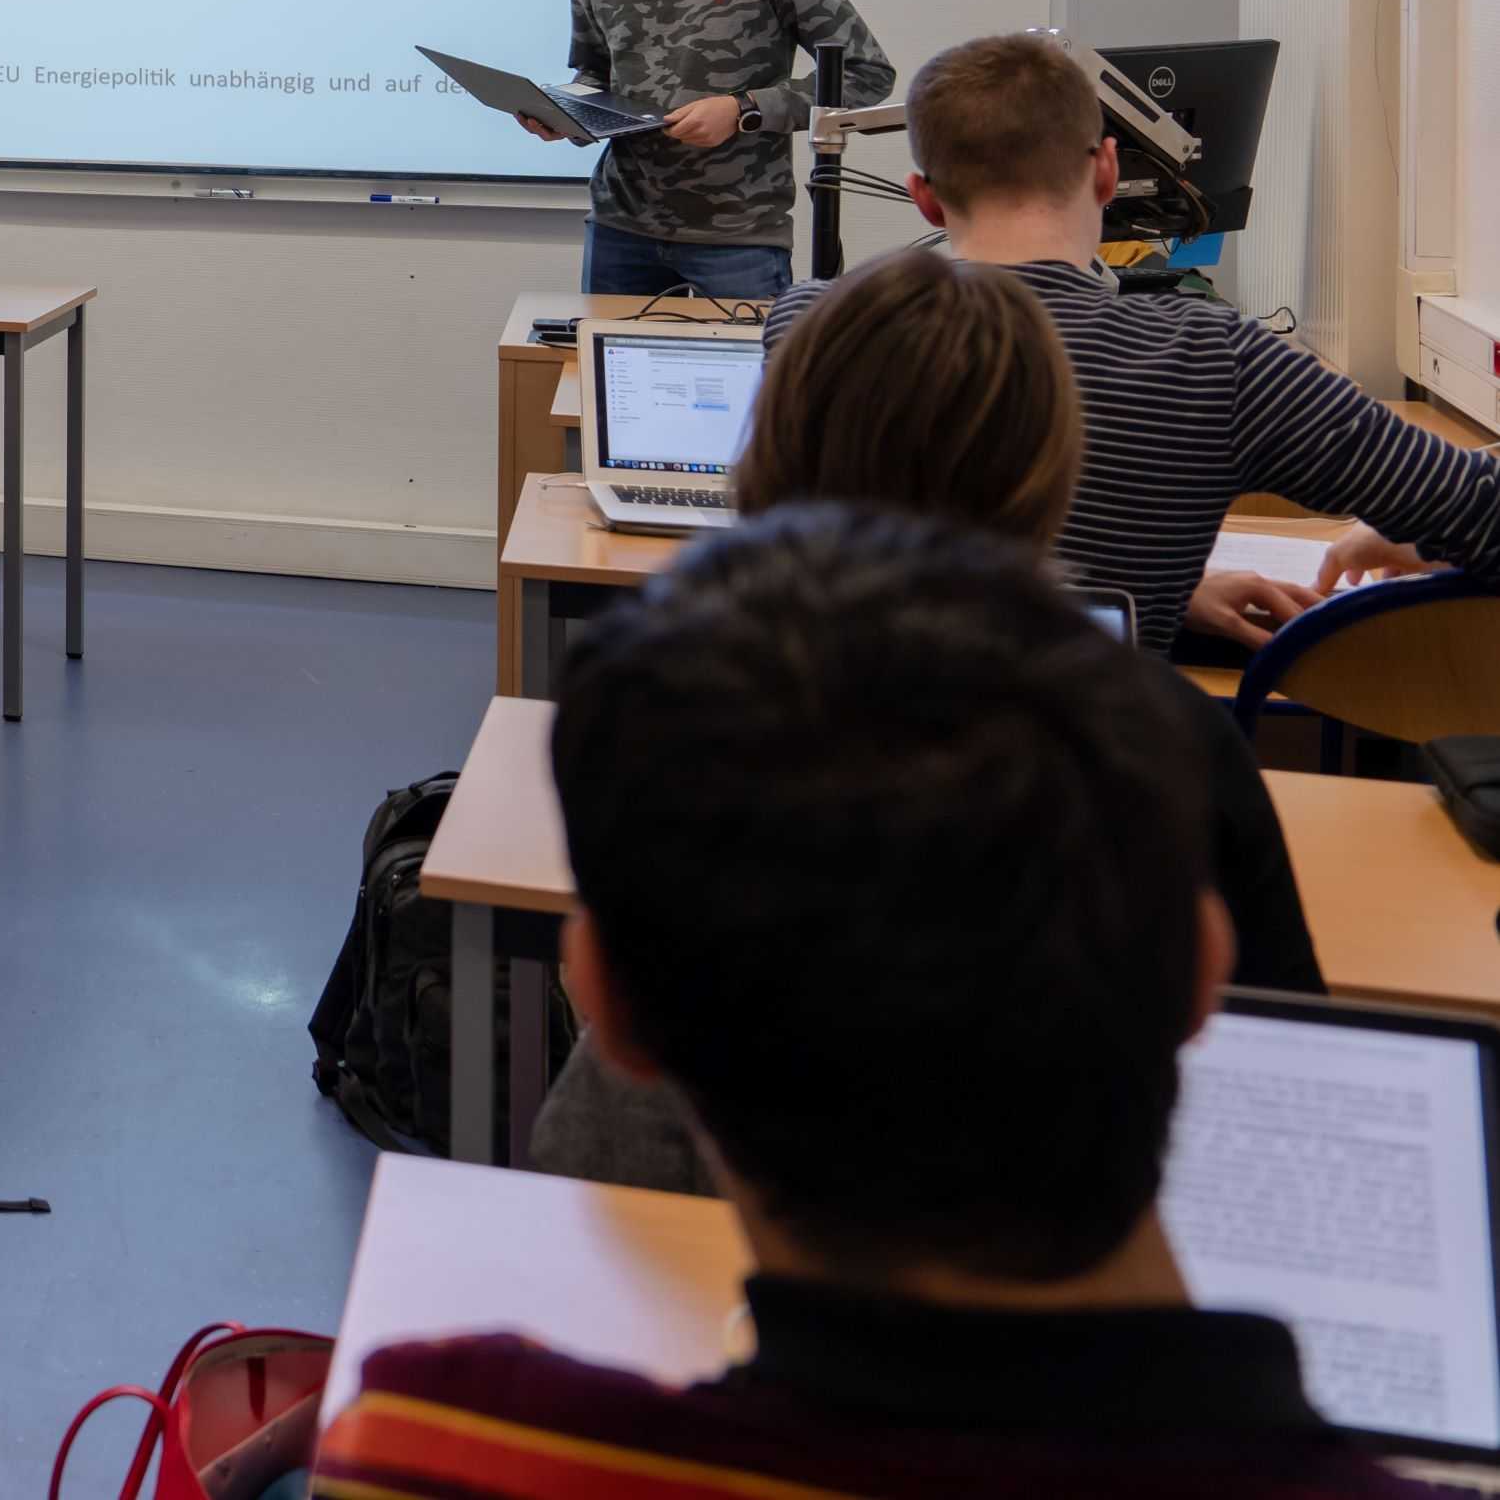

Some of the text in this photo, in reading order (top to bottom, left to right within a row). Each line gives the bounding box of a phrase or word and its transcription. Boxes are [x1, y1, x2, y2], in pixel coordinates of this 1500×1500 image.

[34, 65, 177, 90] Energiepolitik
[189, 69, 316, 95] unabhängig
[329, 71, 371, 93] und
[384, 73, 423, 93] auf
[434, 74, 469, 94] de
[1152, 78, 1174, 87] DELL
